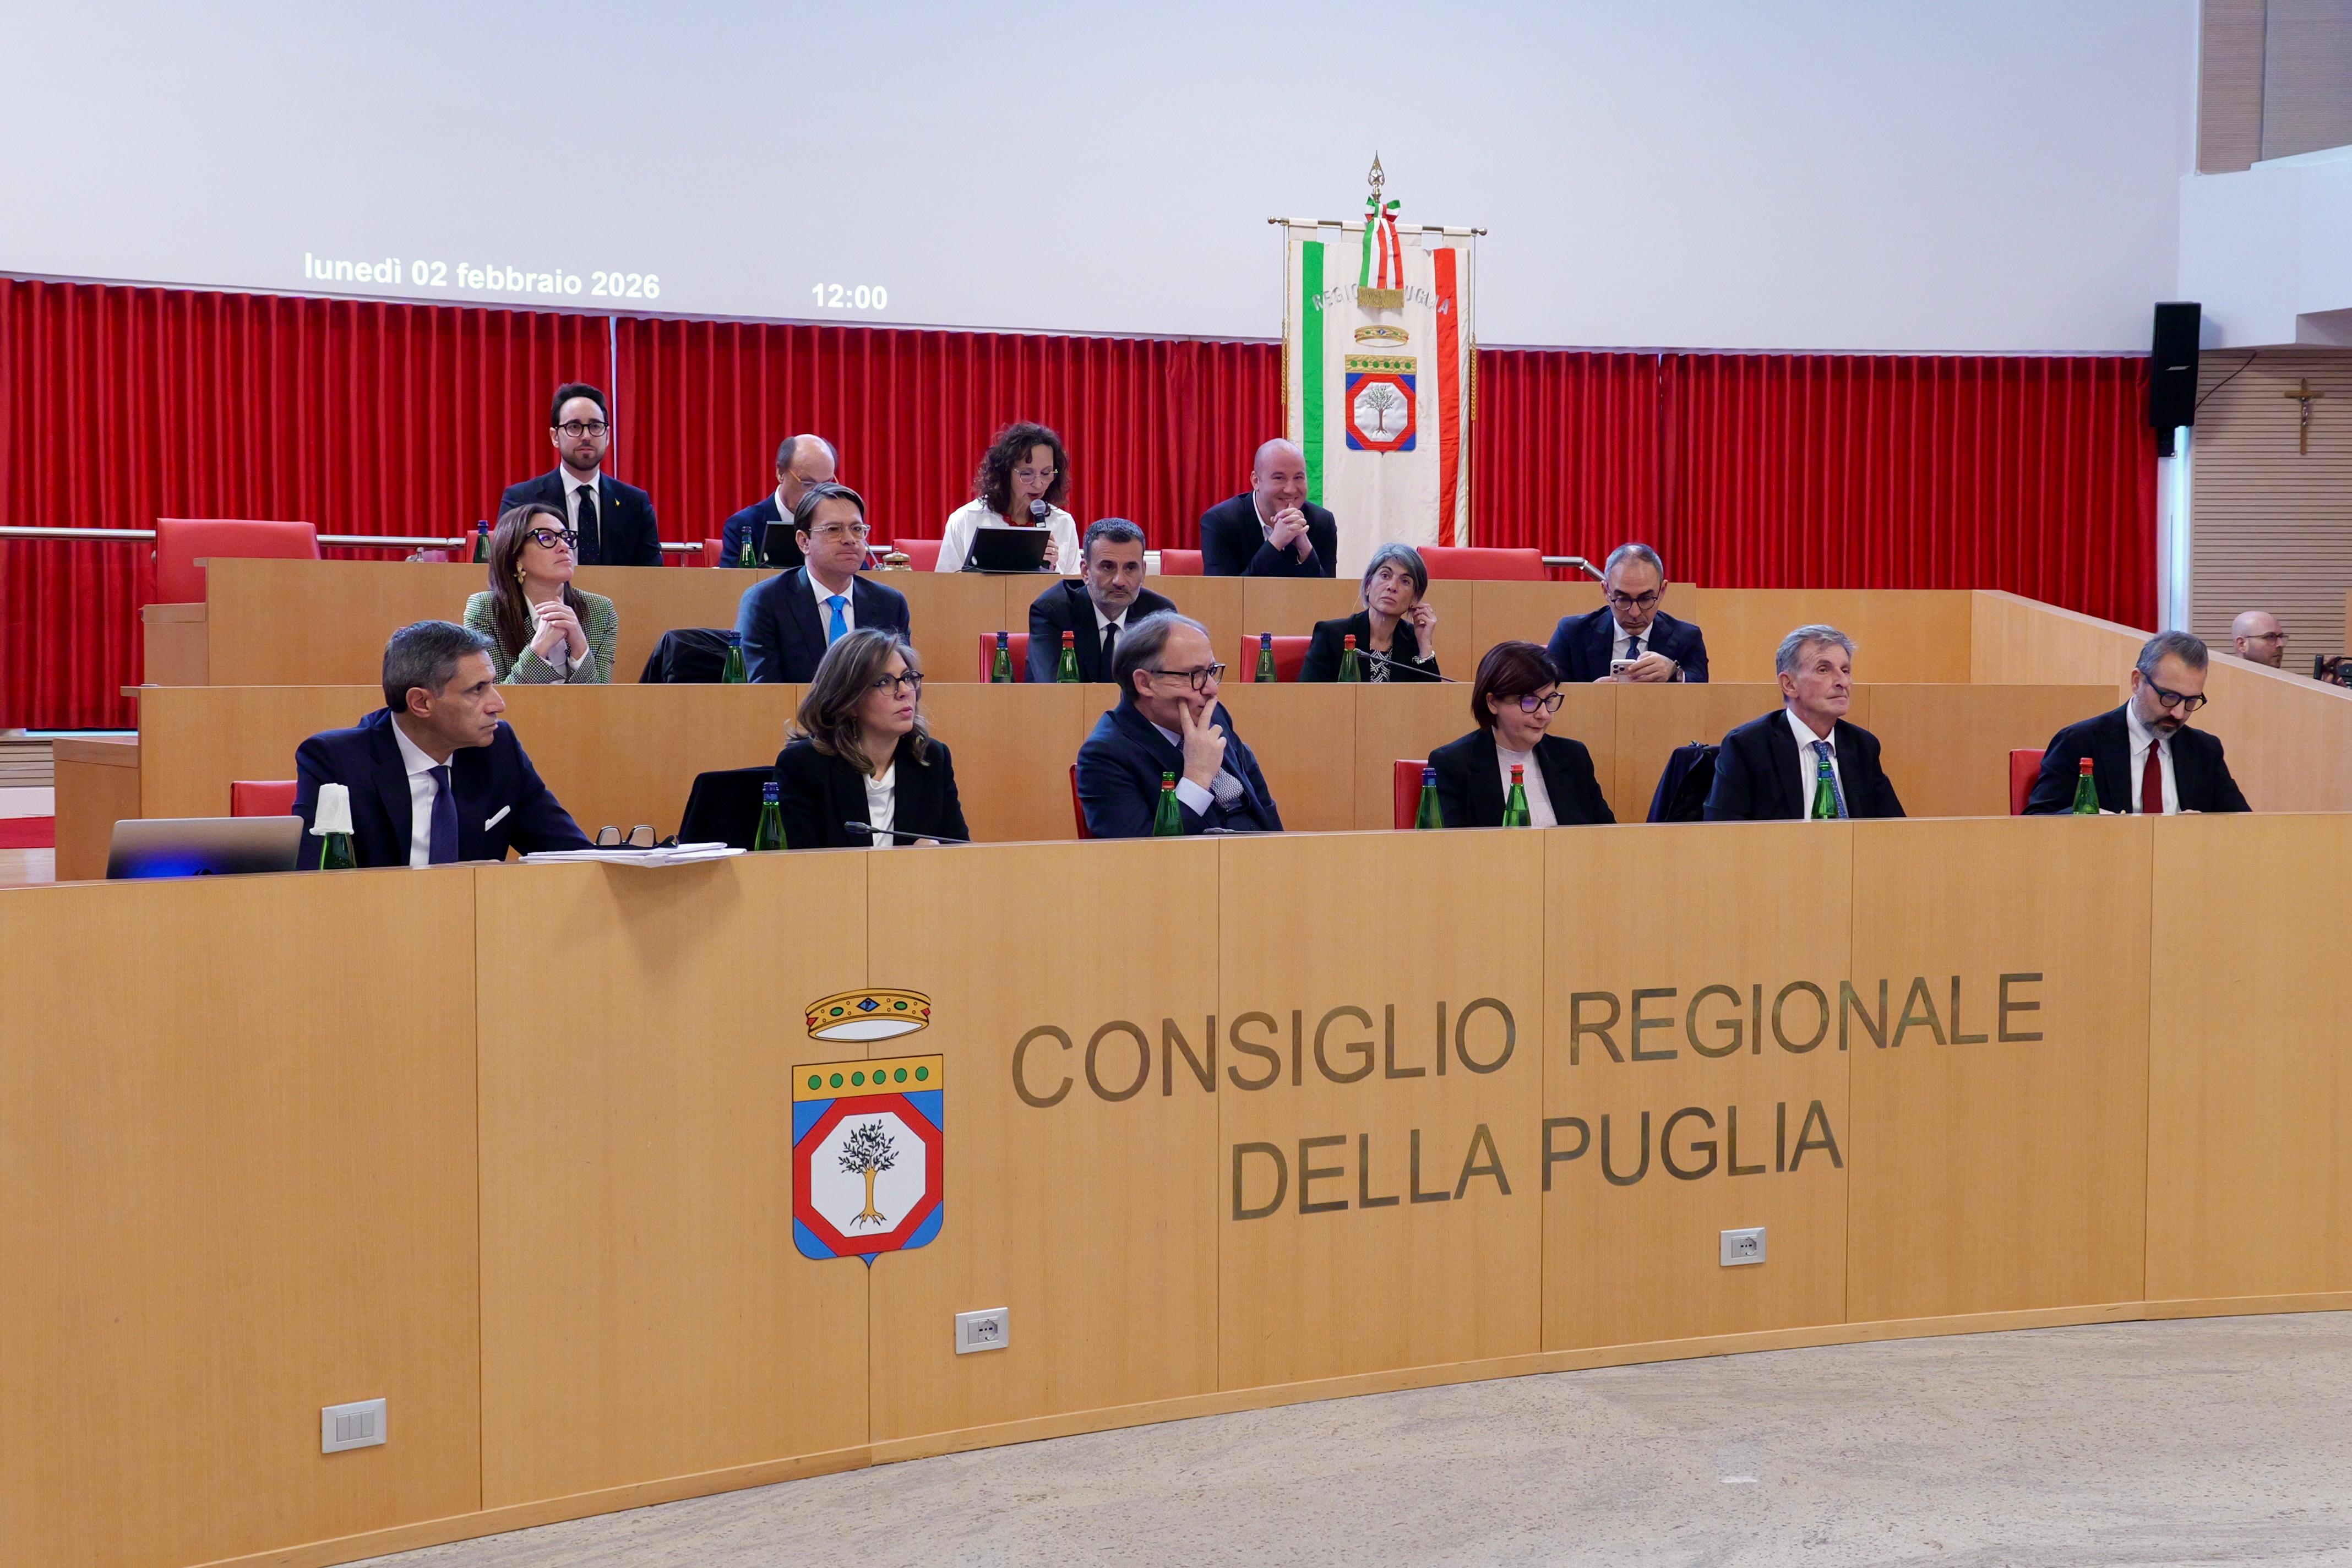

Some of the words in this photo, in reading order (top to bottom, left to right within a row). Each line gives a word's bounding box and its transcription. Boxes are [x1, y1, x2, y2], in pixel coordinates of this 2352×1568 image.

[304, 252, 402, 284] lunedì
[411, 259, 448, 287] 02
[455, 262, 582, 295] febbraio
[590, 270, 660, 300] 2026
[812, 282, 888, 311] 12:00
[1312, 283, 1358, 311] REGIO
[1404, 285, 1450, 315] UGLIA
[1012, 997, 1516, 1108] CONSIGLIO
[1570, 972, 2044, 1065] REGIONALE
[1232, 1124, 1512, 1222] DELLA
[1542, 1100, 1844, 1199] PUGLIA
